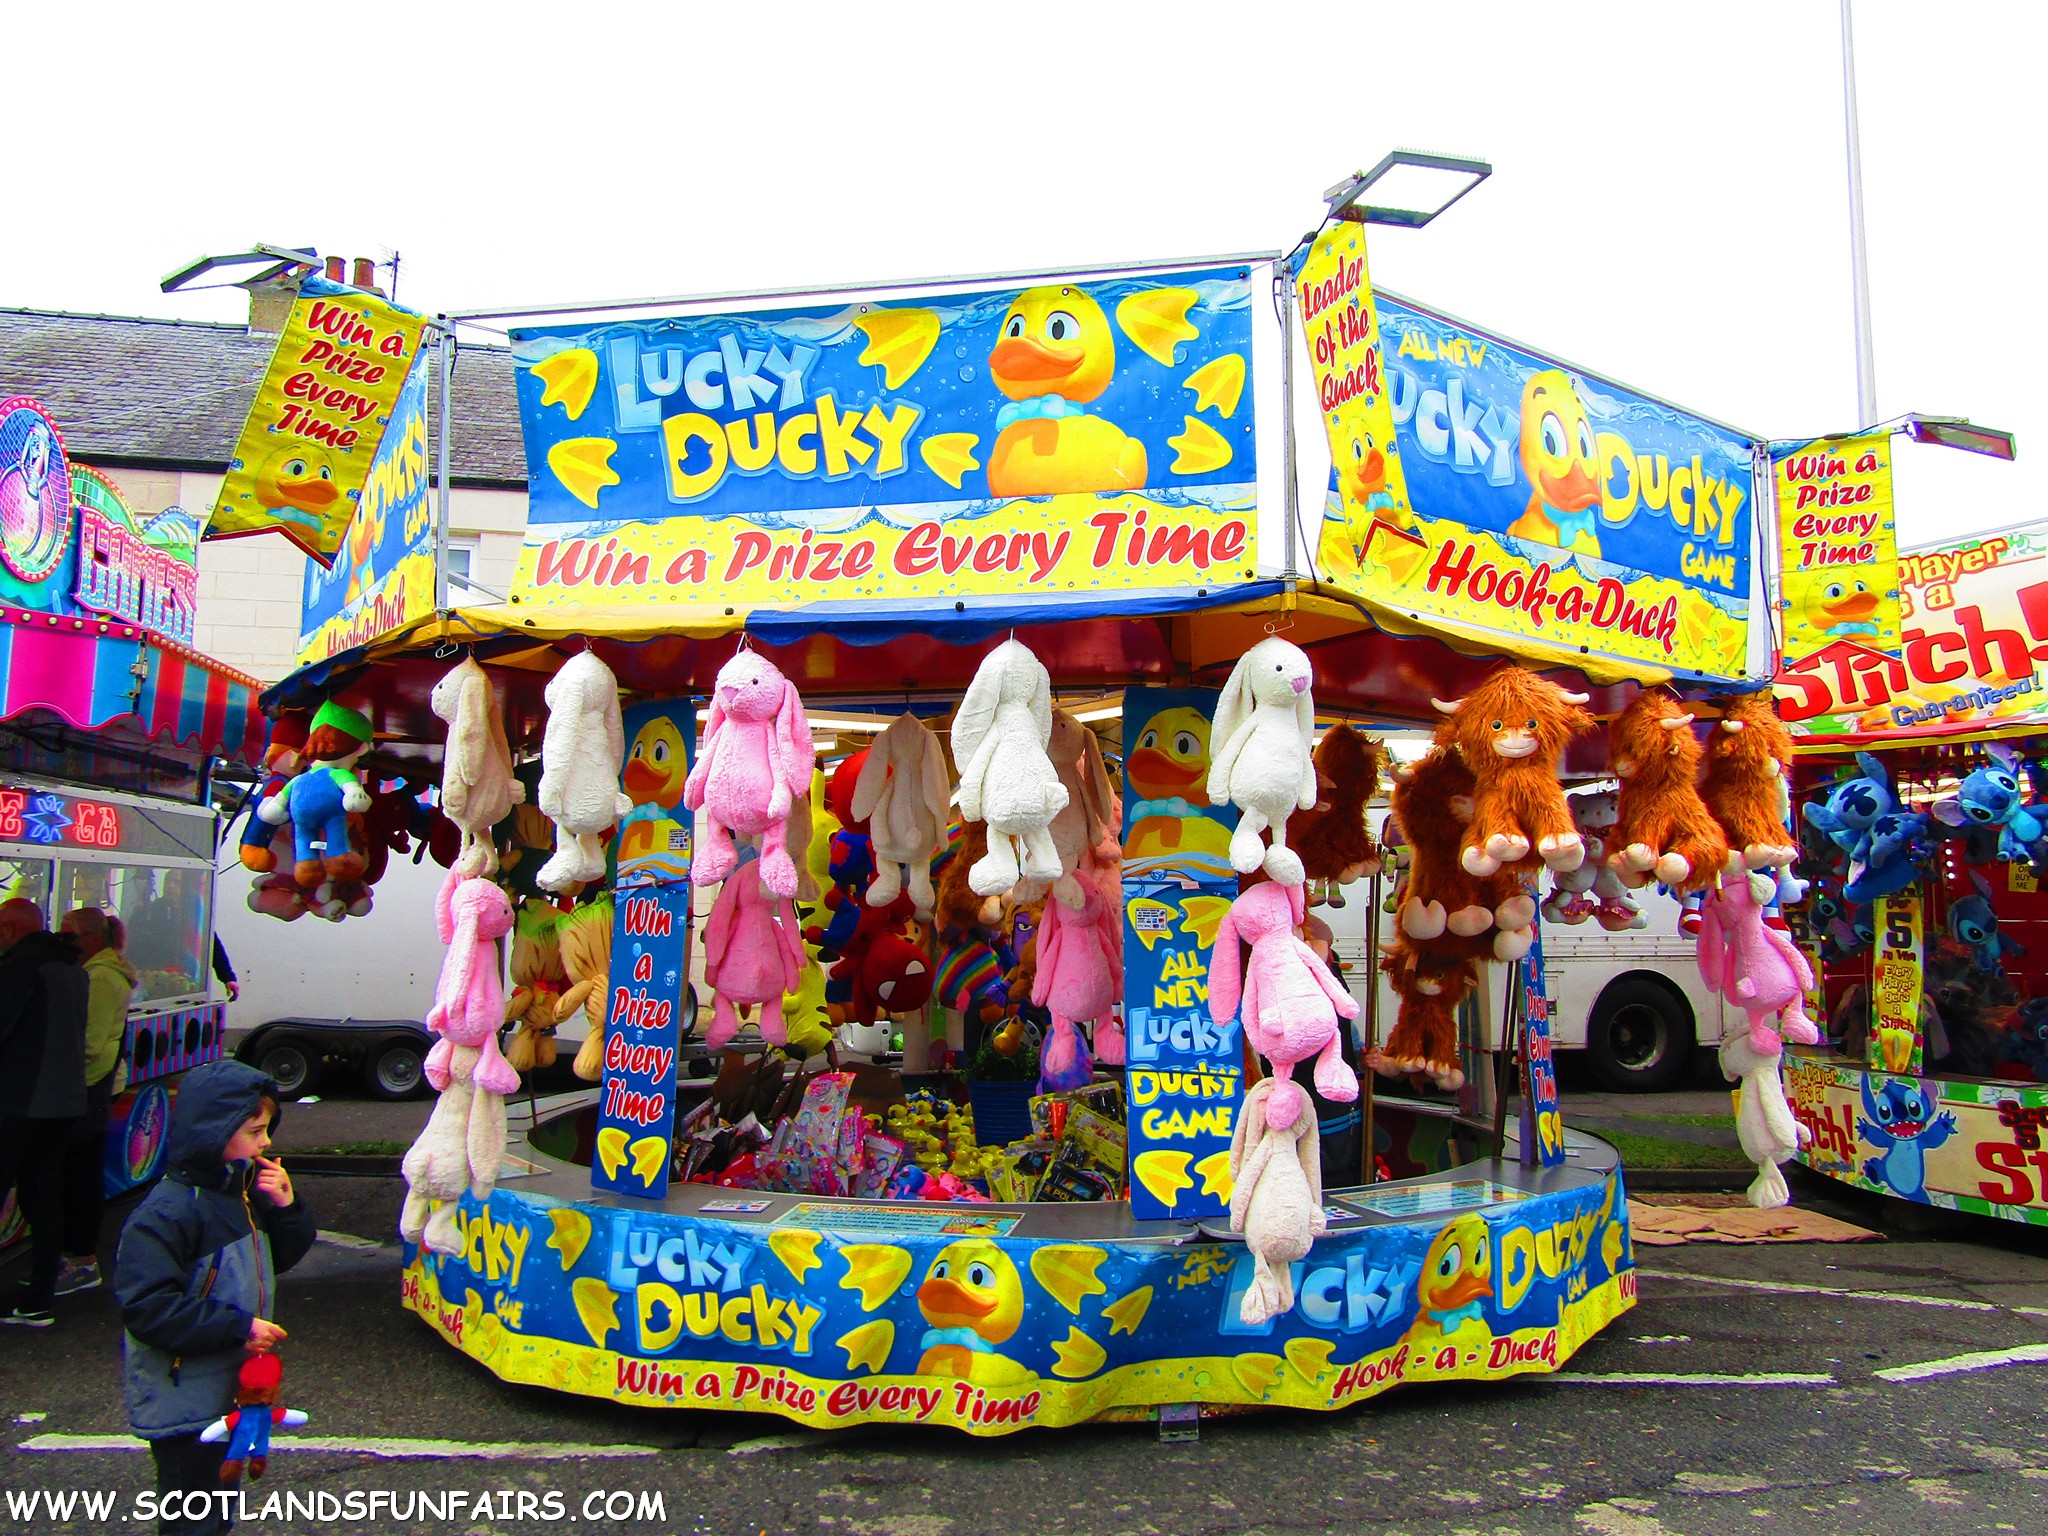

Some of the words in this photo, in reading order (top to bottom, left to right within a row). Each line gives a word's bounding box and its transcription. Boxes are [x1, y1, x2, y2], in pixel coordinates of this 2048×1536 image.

[1303, 255, 1363, 322] Leader
[307, 302, 374, 344] Win
[380, 333, 404, 358] a
[1316, 320, 1336, 368] of
[1338, 305, 1370, 349] the
[1398, 331, 1437, 361] ALL
[1437, 336, 1487, 368] NEW
[301, 339, 385, 384] Prize
[1321, 347, 1380, 412] Quack
[283, 372, 379, 421] Every
[275, 404, 358, 449] Time
[1384, 369, 1521, 479] UCKY
[1786, 455, 1846, 481] Win
[1856, 455, 1877, 473] a
[1796, 483, 1871, 509] Prize
[1793, 511, 1878, 538] Every
[536, 537, 652, 588] Win
[667, 551, 706, 584] a
[724, 531, 874, 584] Prize
[894, 520, 1071, 584] Every
[1090, 510, 1247, 569] Time
[1681, 545, 1736, 591] GAME
[1800, 542, 1873, 567] Time
[1427, 538, 1678, 653] Hook-a-Duck
[1891, 671, 2043, 726] Guaranteed!
[624, 898, 672, 937] Win
[633, 952, 654, 982] a
[1160, 950, 1207, 982] ALL
[612, 987, 671, 1029] Prize
[606, 1034, 674, 1083] Every
[605, 1081, 665, 1126] Time
[1141, 1107, 1233, 1139] GAME
[1177, 1258, 1236, 1290] NEW
[1184, 1247, 1227, 1270] ALL
[1333, 1345, 1405, 1399] Hook
[1487, 1329, 1558, 1369] Duck
[616, 1357, 684, 1397] Win
[695, 1375, 721, 1398] a
[733, 1366, 817, 1413] Prize
[827, 1380, 940, 1420] Every
[953, 1382, 1041, 1425] Time
